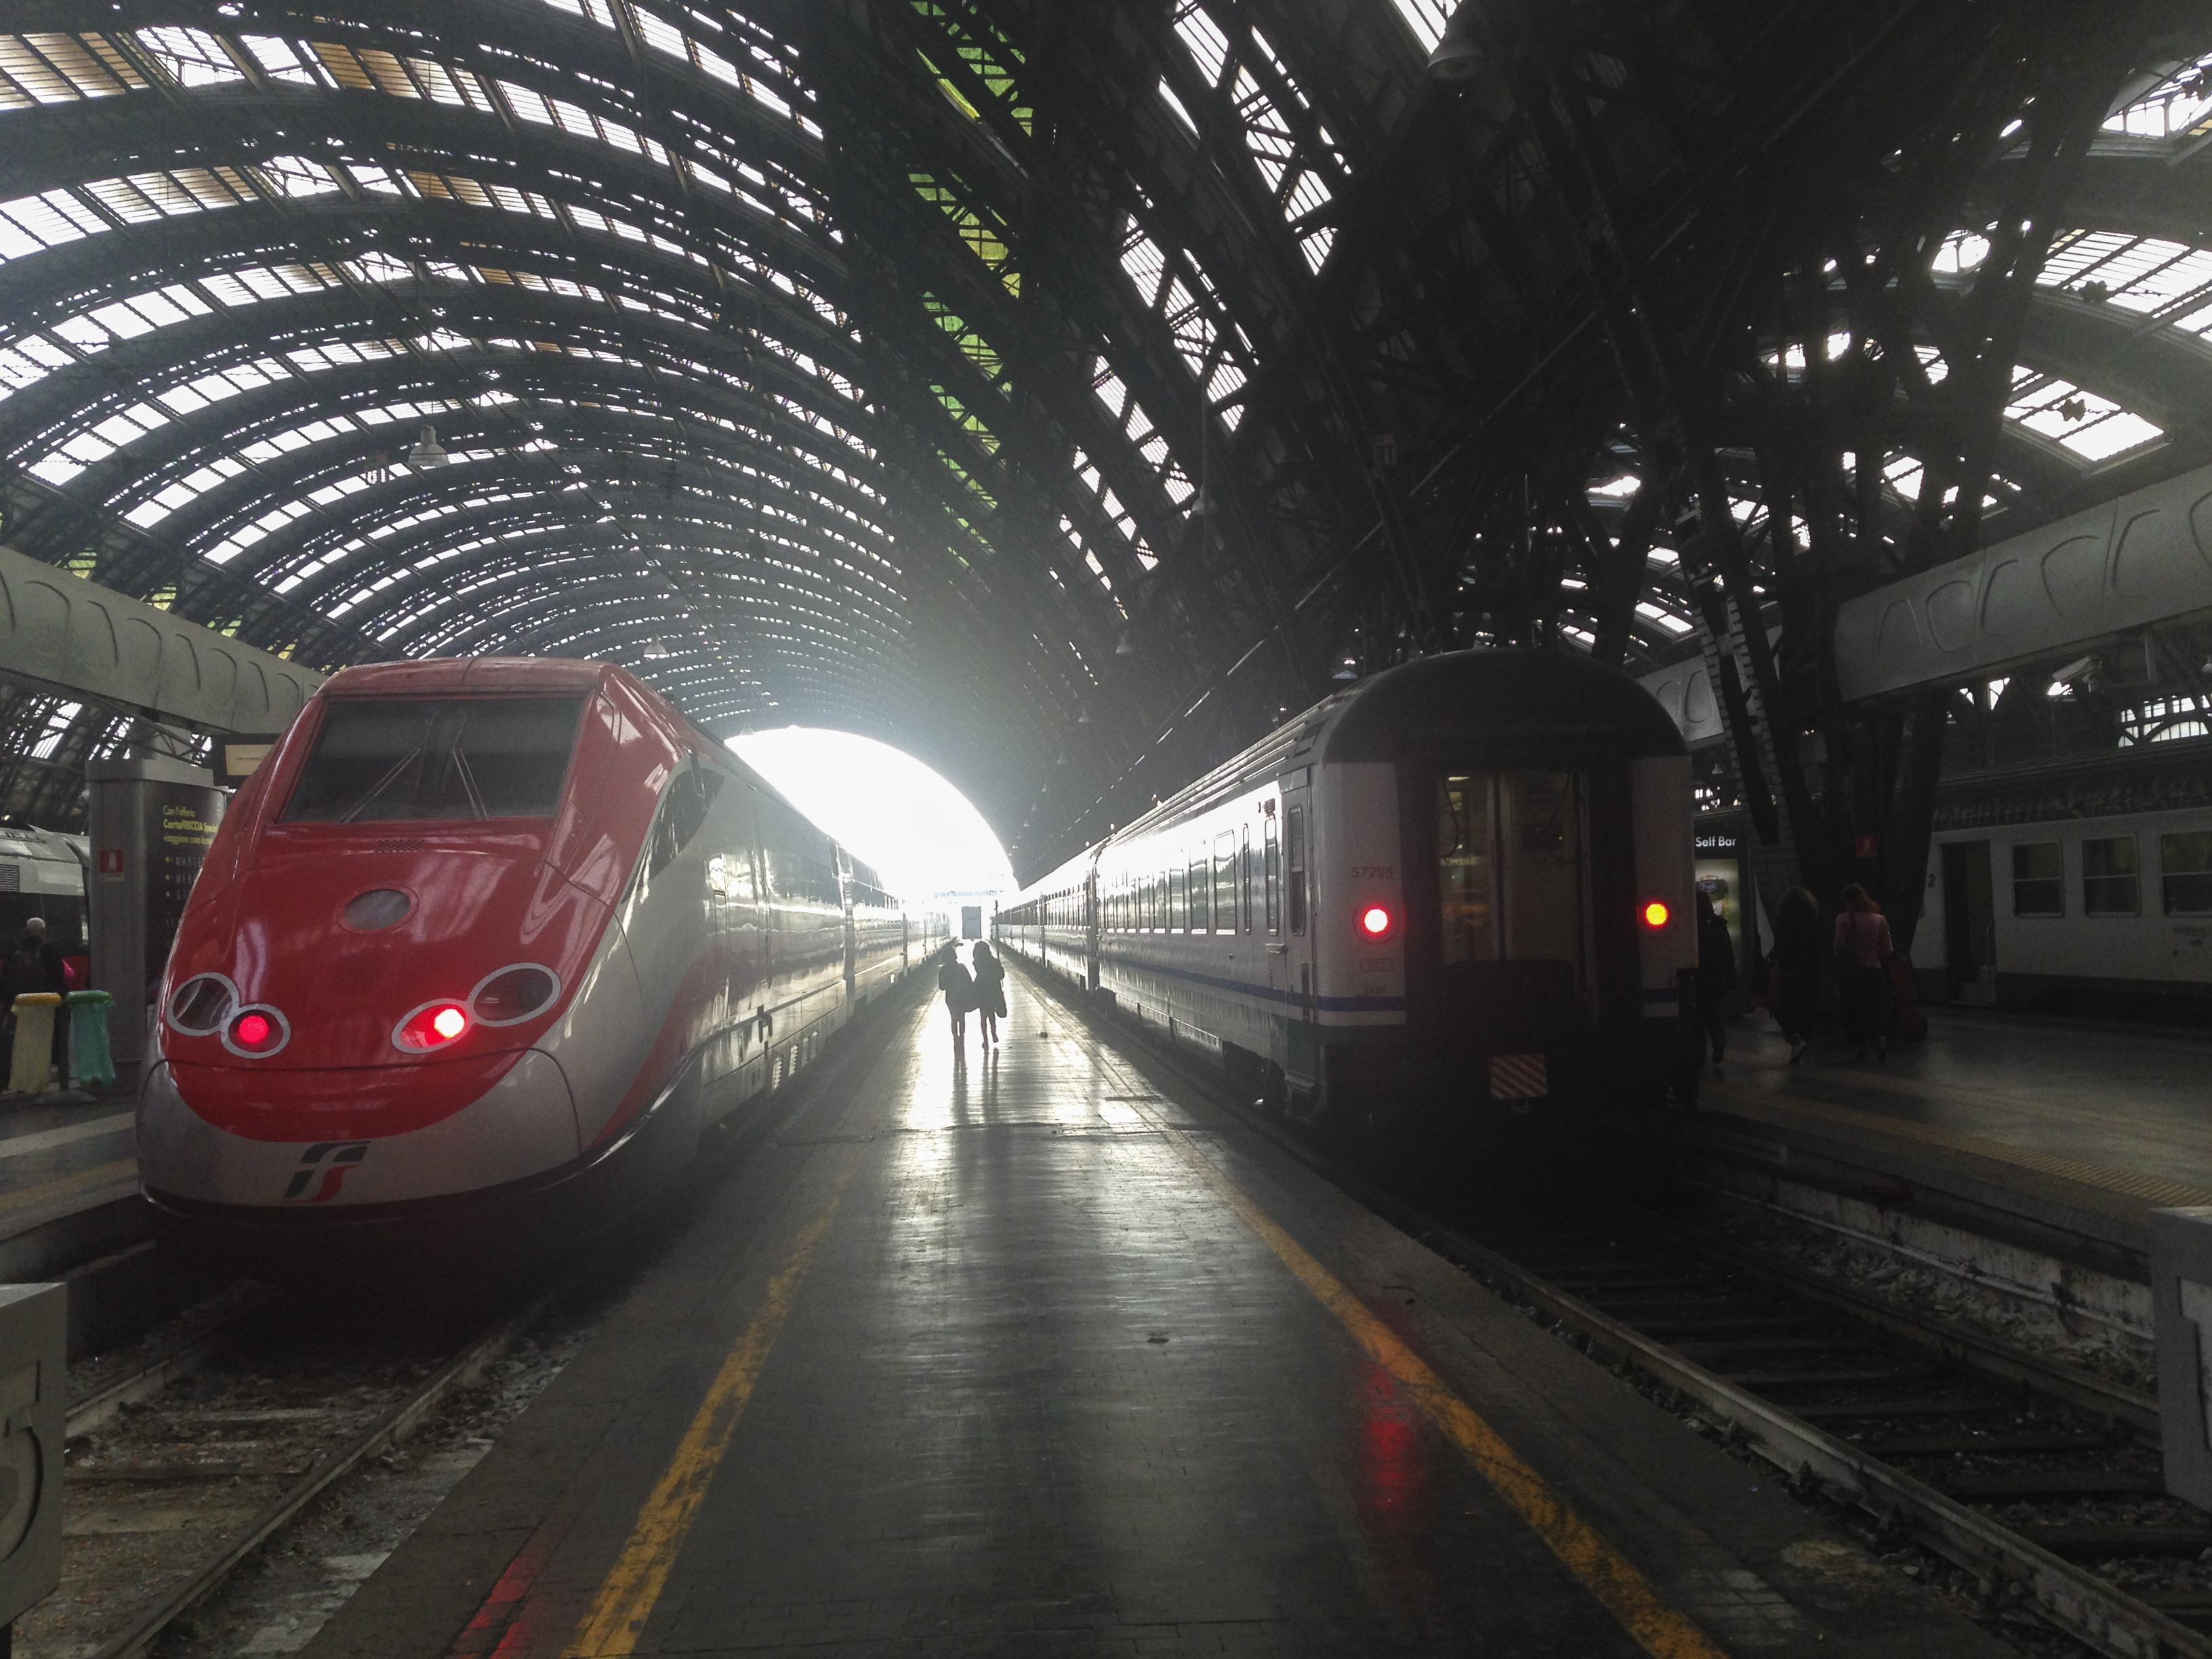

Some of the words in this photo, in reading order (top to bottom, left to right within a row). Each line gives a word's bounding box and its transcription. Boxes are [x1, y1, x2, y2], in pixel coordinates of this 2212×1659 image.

[1695, 836, 1716, 847] Self
[1718, 836, 1736, 846] Bar
[1352, 866, 1393, 878] 57295
[1928, 873, 1936, 888] 2
